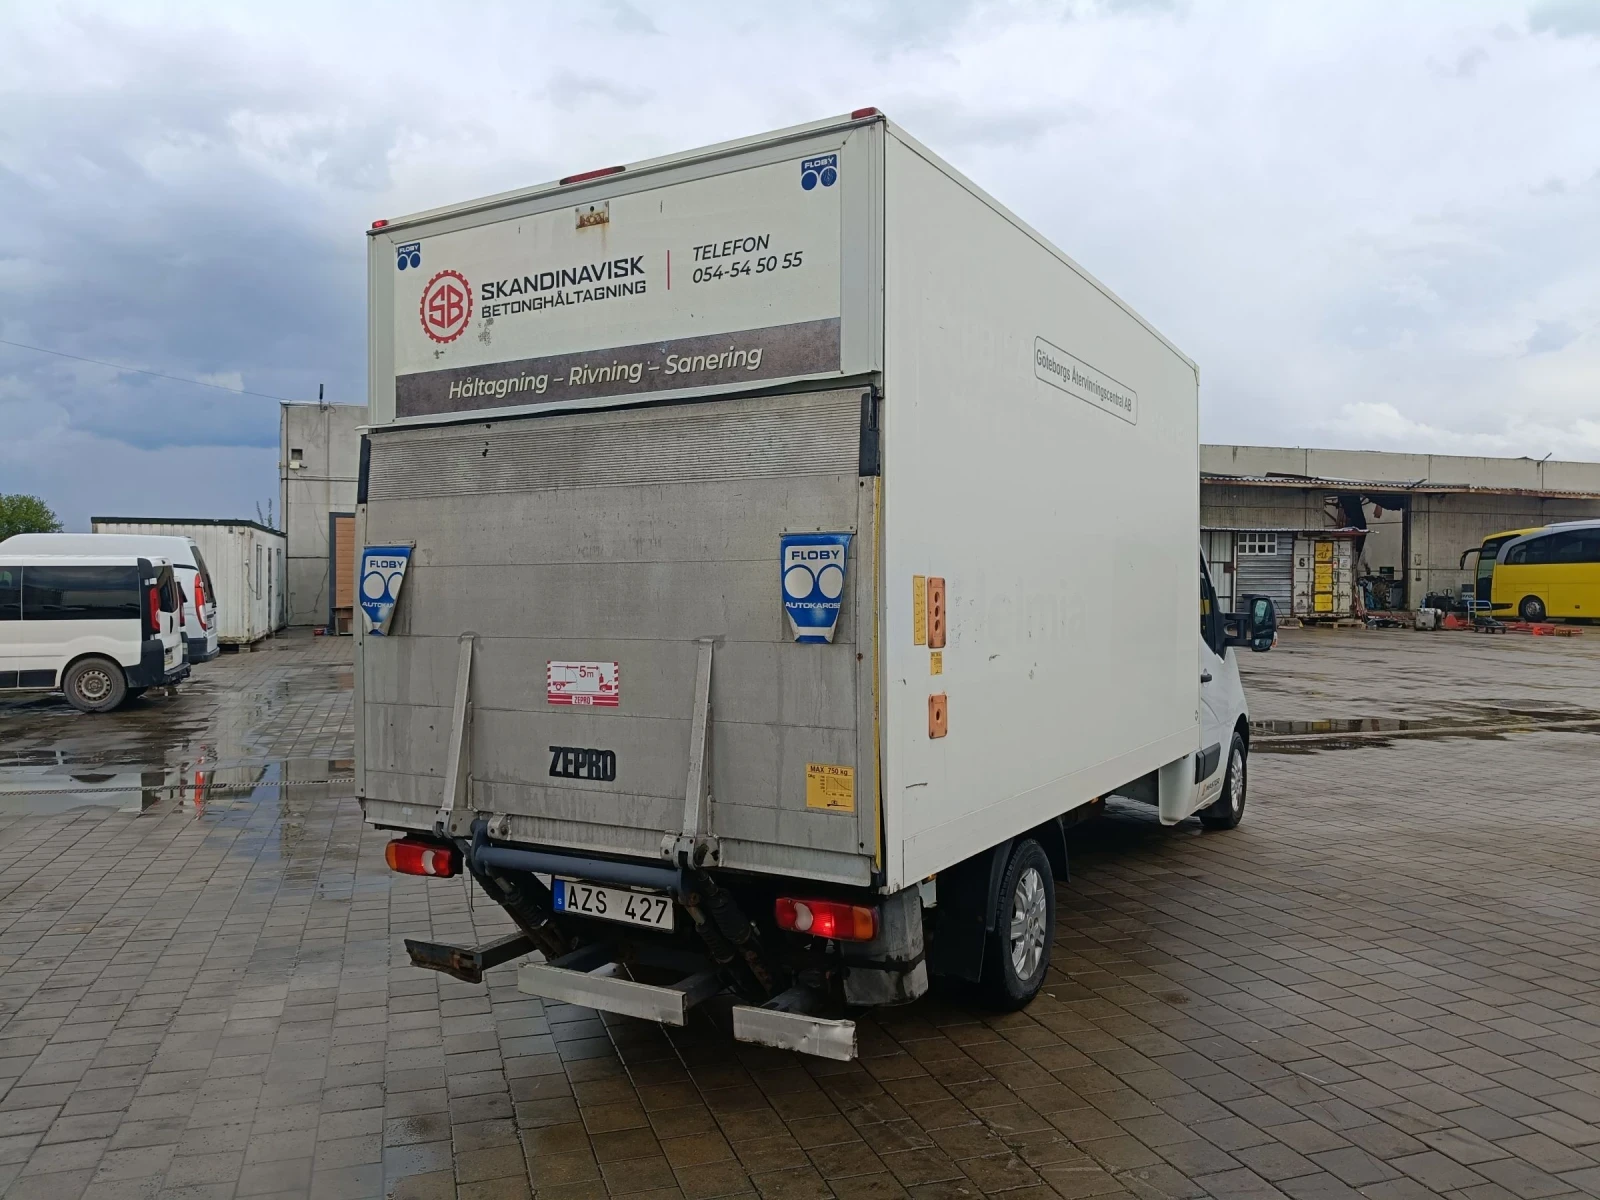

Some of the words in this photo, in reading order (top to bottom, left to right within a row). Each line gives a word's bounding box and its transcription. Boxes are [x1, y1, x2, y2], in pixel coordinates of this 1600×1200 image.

[804, 157, 834, 169] FLOBY
[693, 234, 770, 261] TELEFON
[481, 255, 645, 301] SKANDINAVISK
[693, 260, 751, 283] 054-54
[755, 256, 777, 274] 50
[782, 251, 803, 269] 55
[429, 284, 464, 329] SB
[481, 280, 647, 319] BETONGHÅLTAGNING
[449, 371, 549, 399] Håltagning
[569, 361, 643, 386] Rivning
[664, 345, 764, 375] Sanering
[1036, 349, 1071, 383] Göteborgs
[1072, 365, 1124, 409] Återvinningscentral
[1123, 398, 1132, 412] AB
[369, 560, 404, 569] FLOBY
[791, 550, 840, 561] FLOBY
[574, 696, 591, 705] ZEPRO
[549, 745, 616, 782] ZEPRO
[810, 765, 825, 773] MAX
[568, 886, 607, 914] AZS
[624, 895, 668, 924] 427
